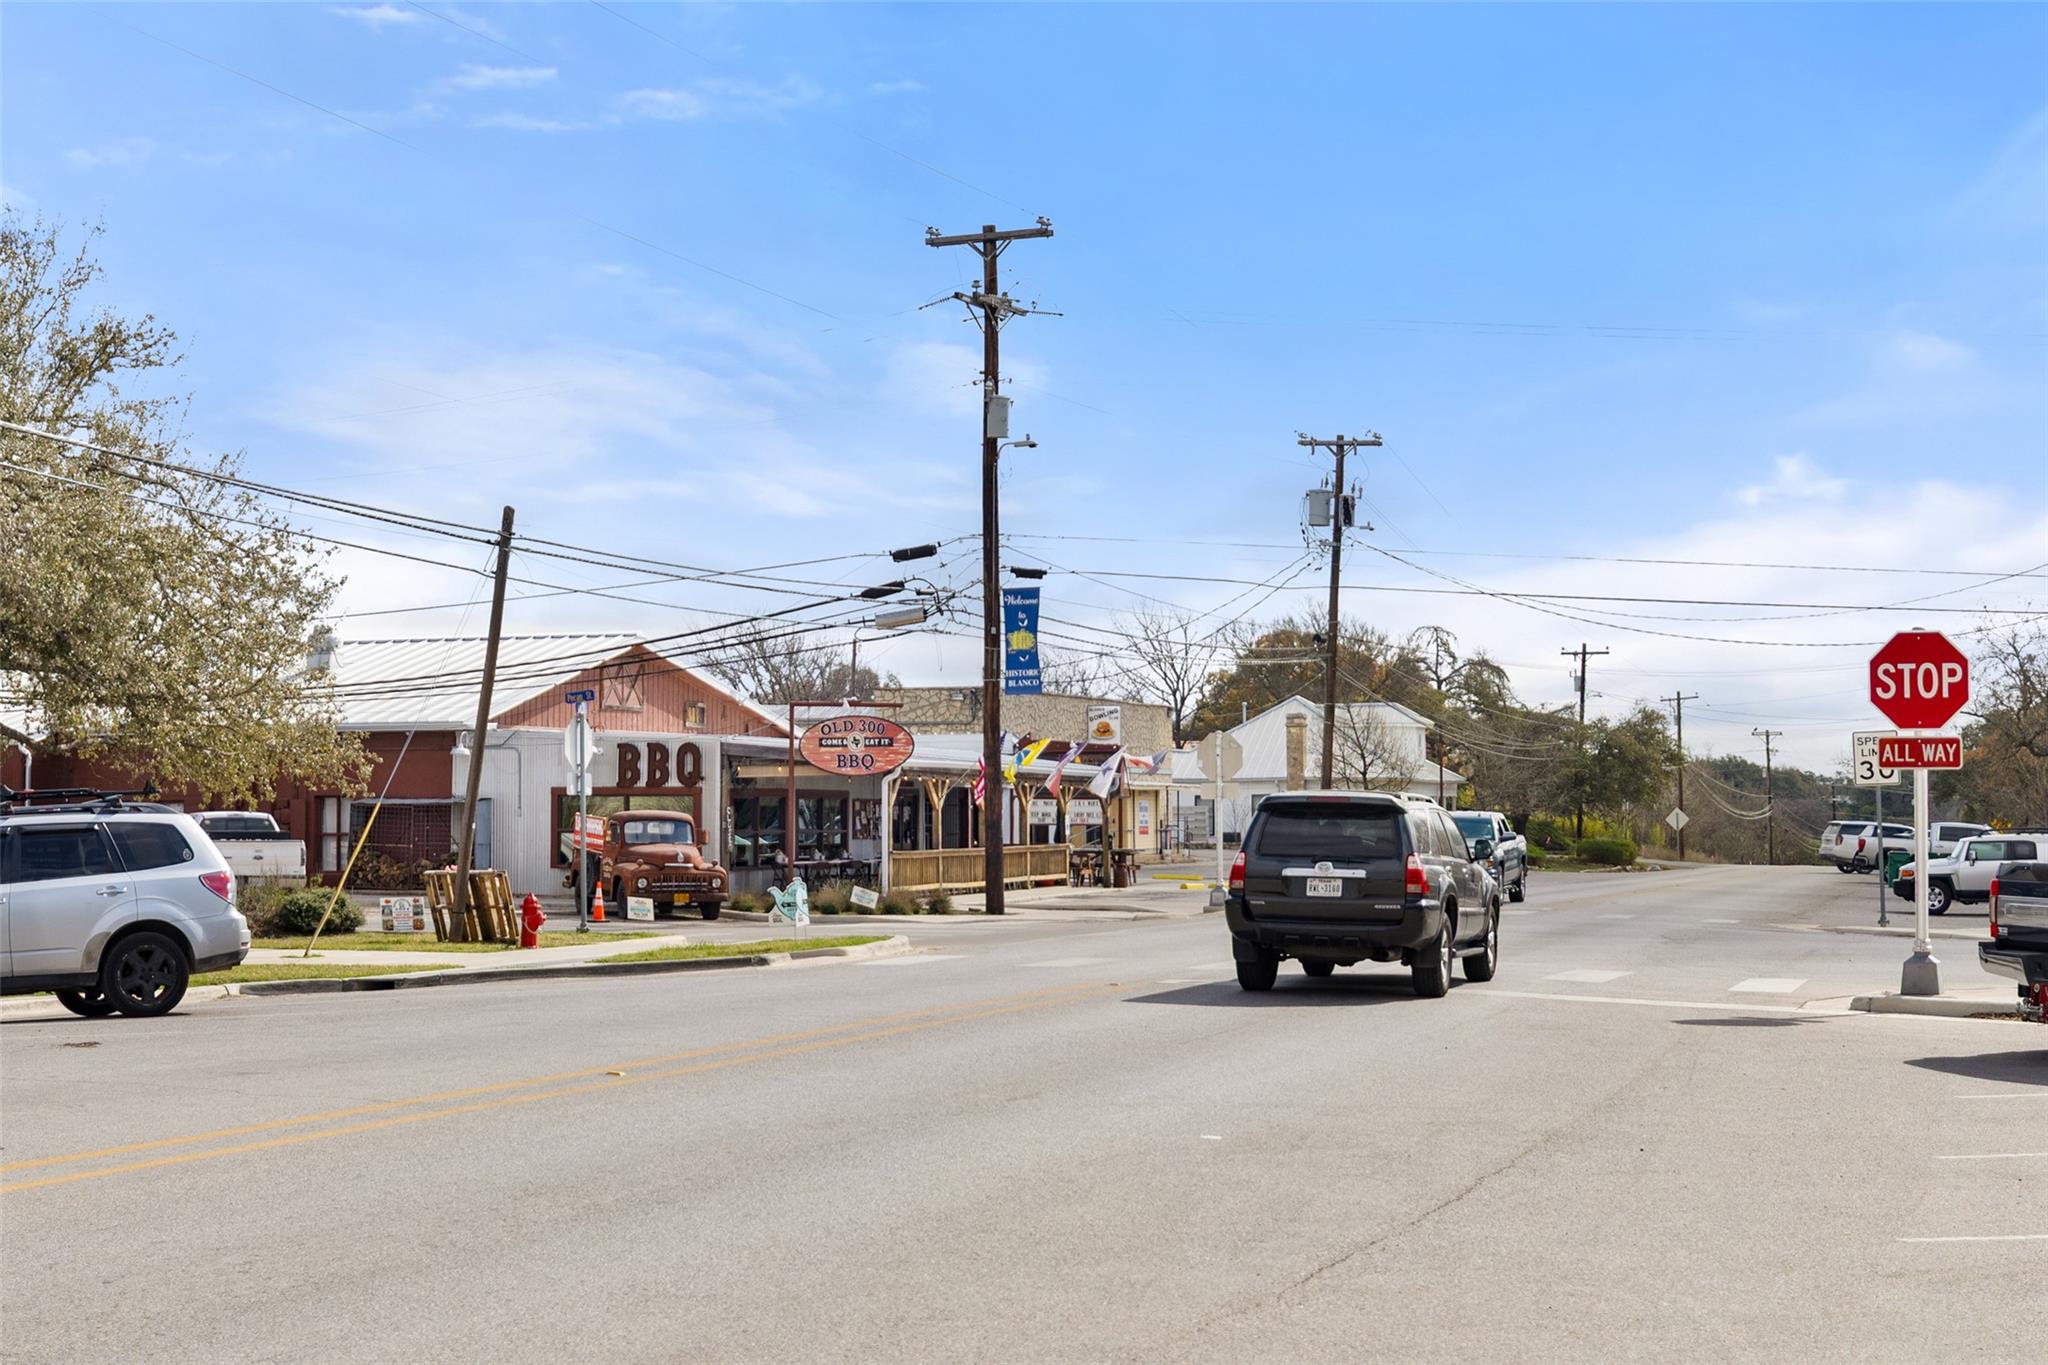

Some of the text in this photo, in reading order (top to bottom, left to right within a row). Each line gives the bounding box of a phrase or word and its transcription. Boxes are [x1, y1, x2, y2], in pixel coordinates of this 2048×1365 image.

[1004, 594, 1038, 606] Welcome
[1018, 611, 1026, 619] to
[1005, 669, 1040, 677] HISTORIC
[1008, 679, 1040, 687] BLANCO
[1876, 662, 1963, 699] STOP
[1089, 707, 1119, 722] BOWLING
[821, 719, 886, 736] OLD 300
[865, 738, 879, 746] EAT
[1857, 736, 1878, 746] SPE
[1882, 743, 1958, 763] ALL WAY
[616, 742, 705, 787] BBQ
[837, 754, 875, 771] BBQ
